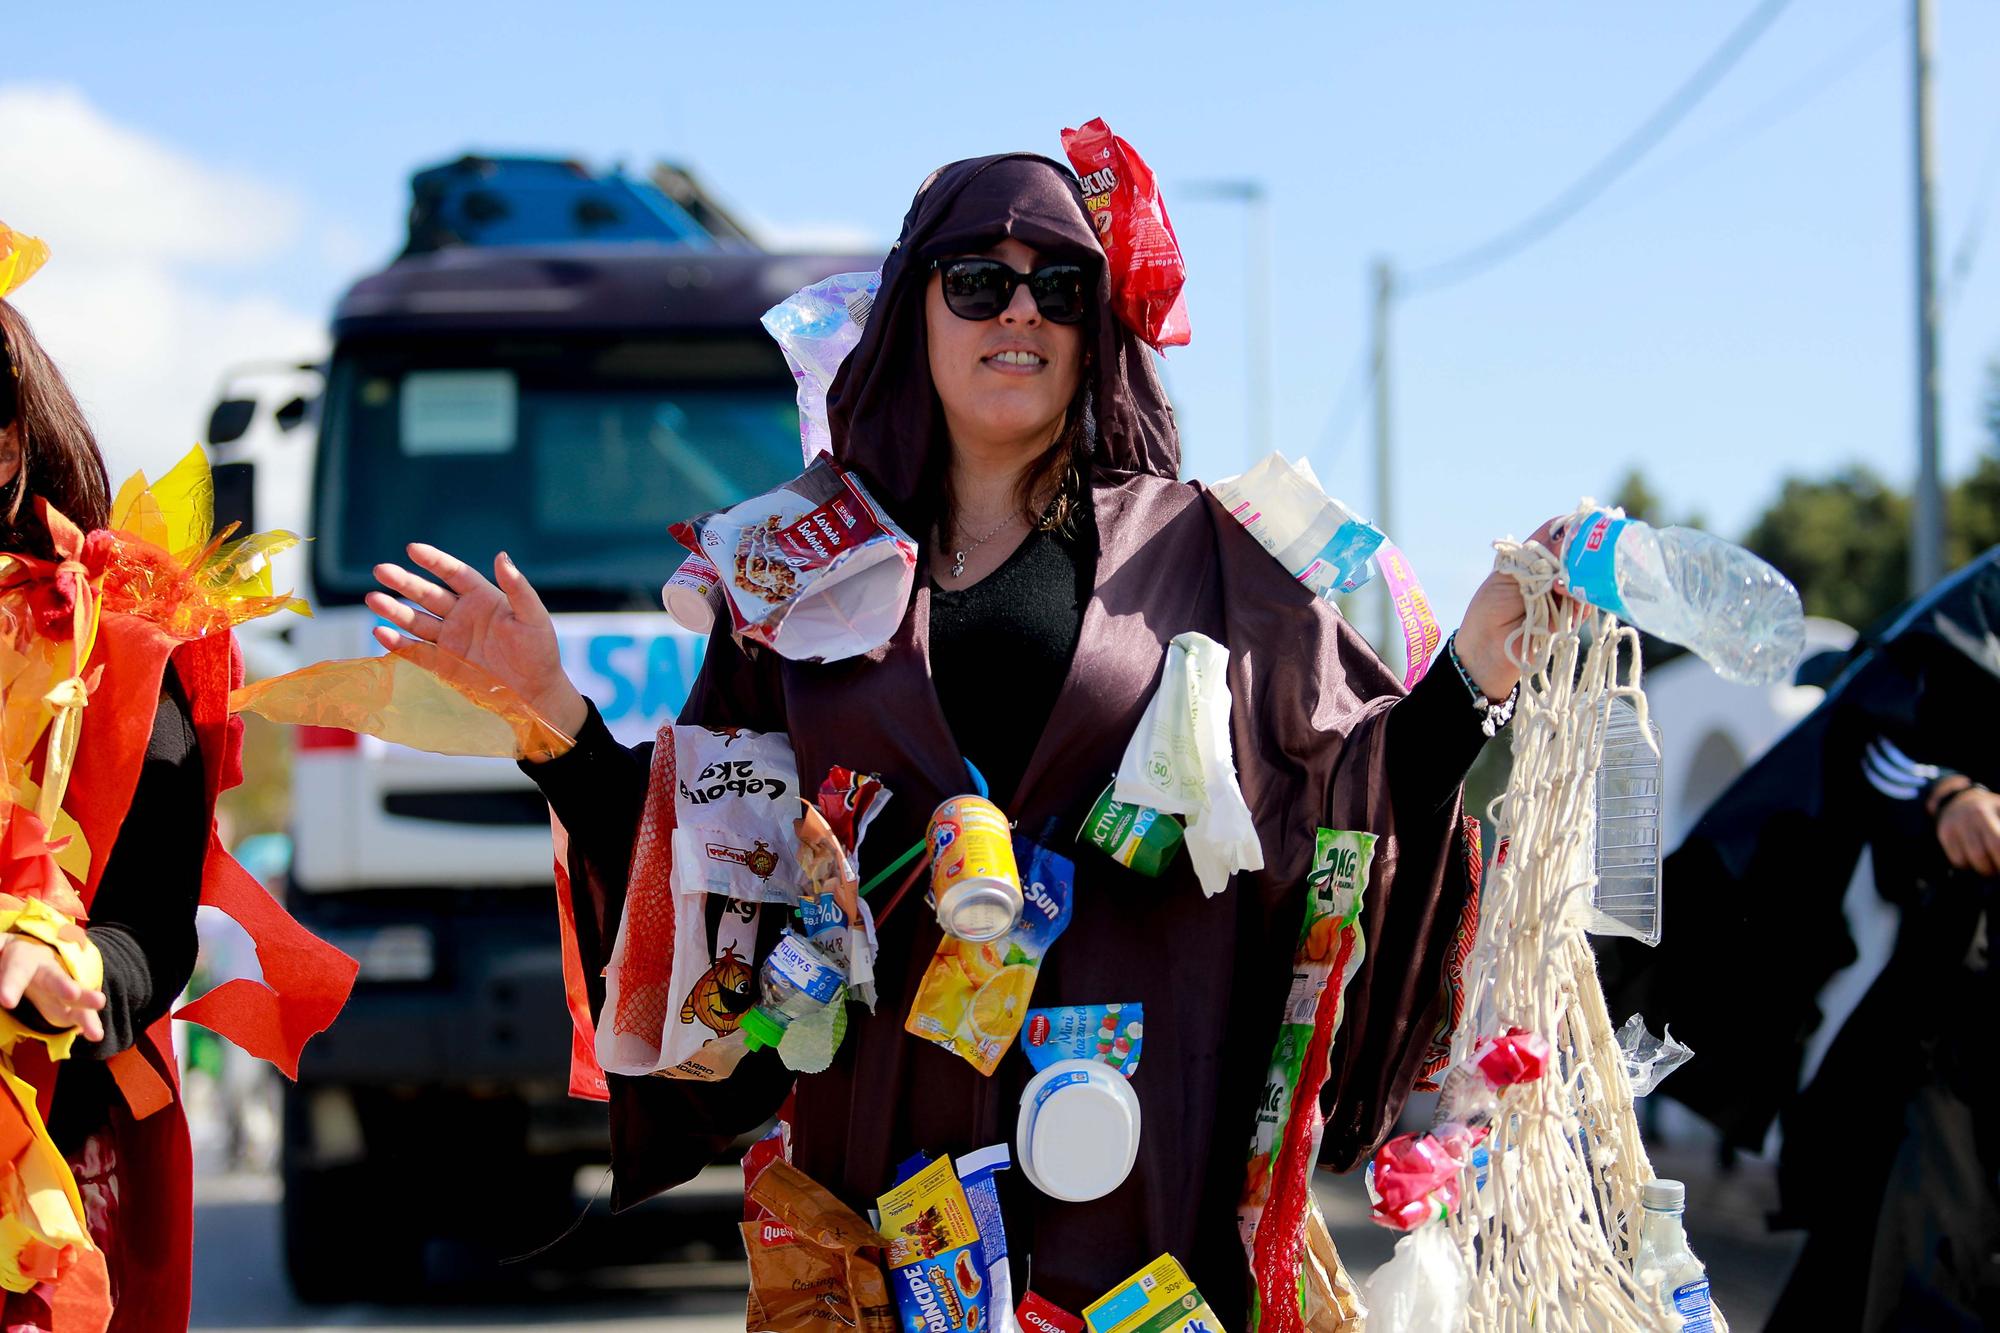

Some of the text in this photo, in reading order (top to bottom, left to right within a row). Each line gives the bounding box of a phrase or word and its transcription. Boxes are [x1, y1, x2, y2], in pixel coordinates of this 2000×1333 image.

[1101, 147, 1110, 160] 6
[1080, 167, 1117, 198] YCAO
[1084, 191, 1111, 213] NIS
[838, 505, 851, 521] SPAR
[797, 521, 829, 560] Boloñesa
[812, 512, 840, 547] Lasaña
[1154, 764, 1168, 777] 50
[678, 778, 787, 805] Cebolla
[1031, 1014, 1046, 1049] Milbona
[1058, 1015, 1074, 1047] Mini
[682, 1059, 715, 1076] ARRO
[904, 1265, 948, 1333] RINCIPE
[1165, 1280, 1181, 1296] 30g
